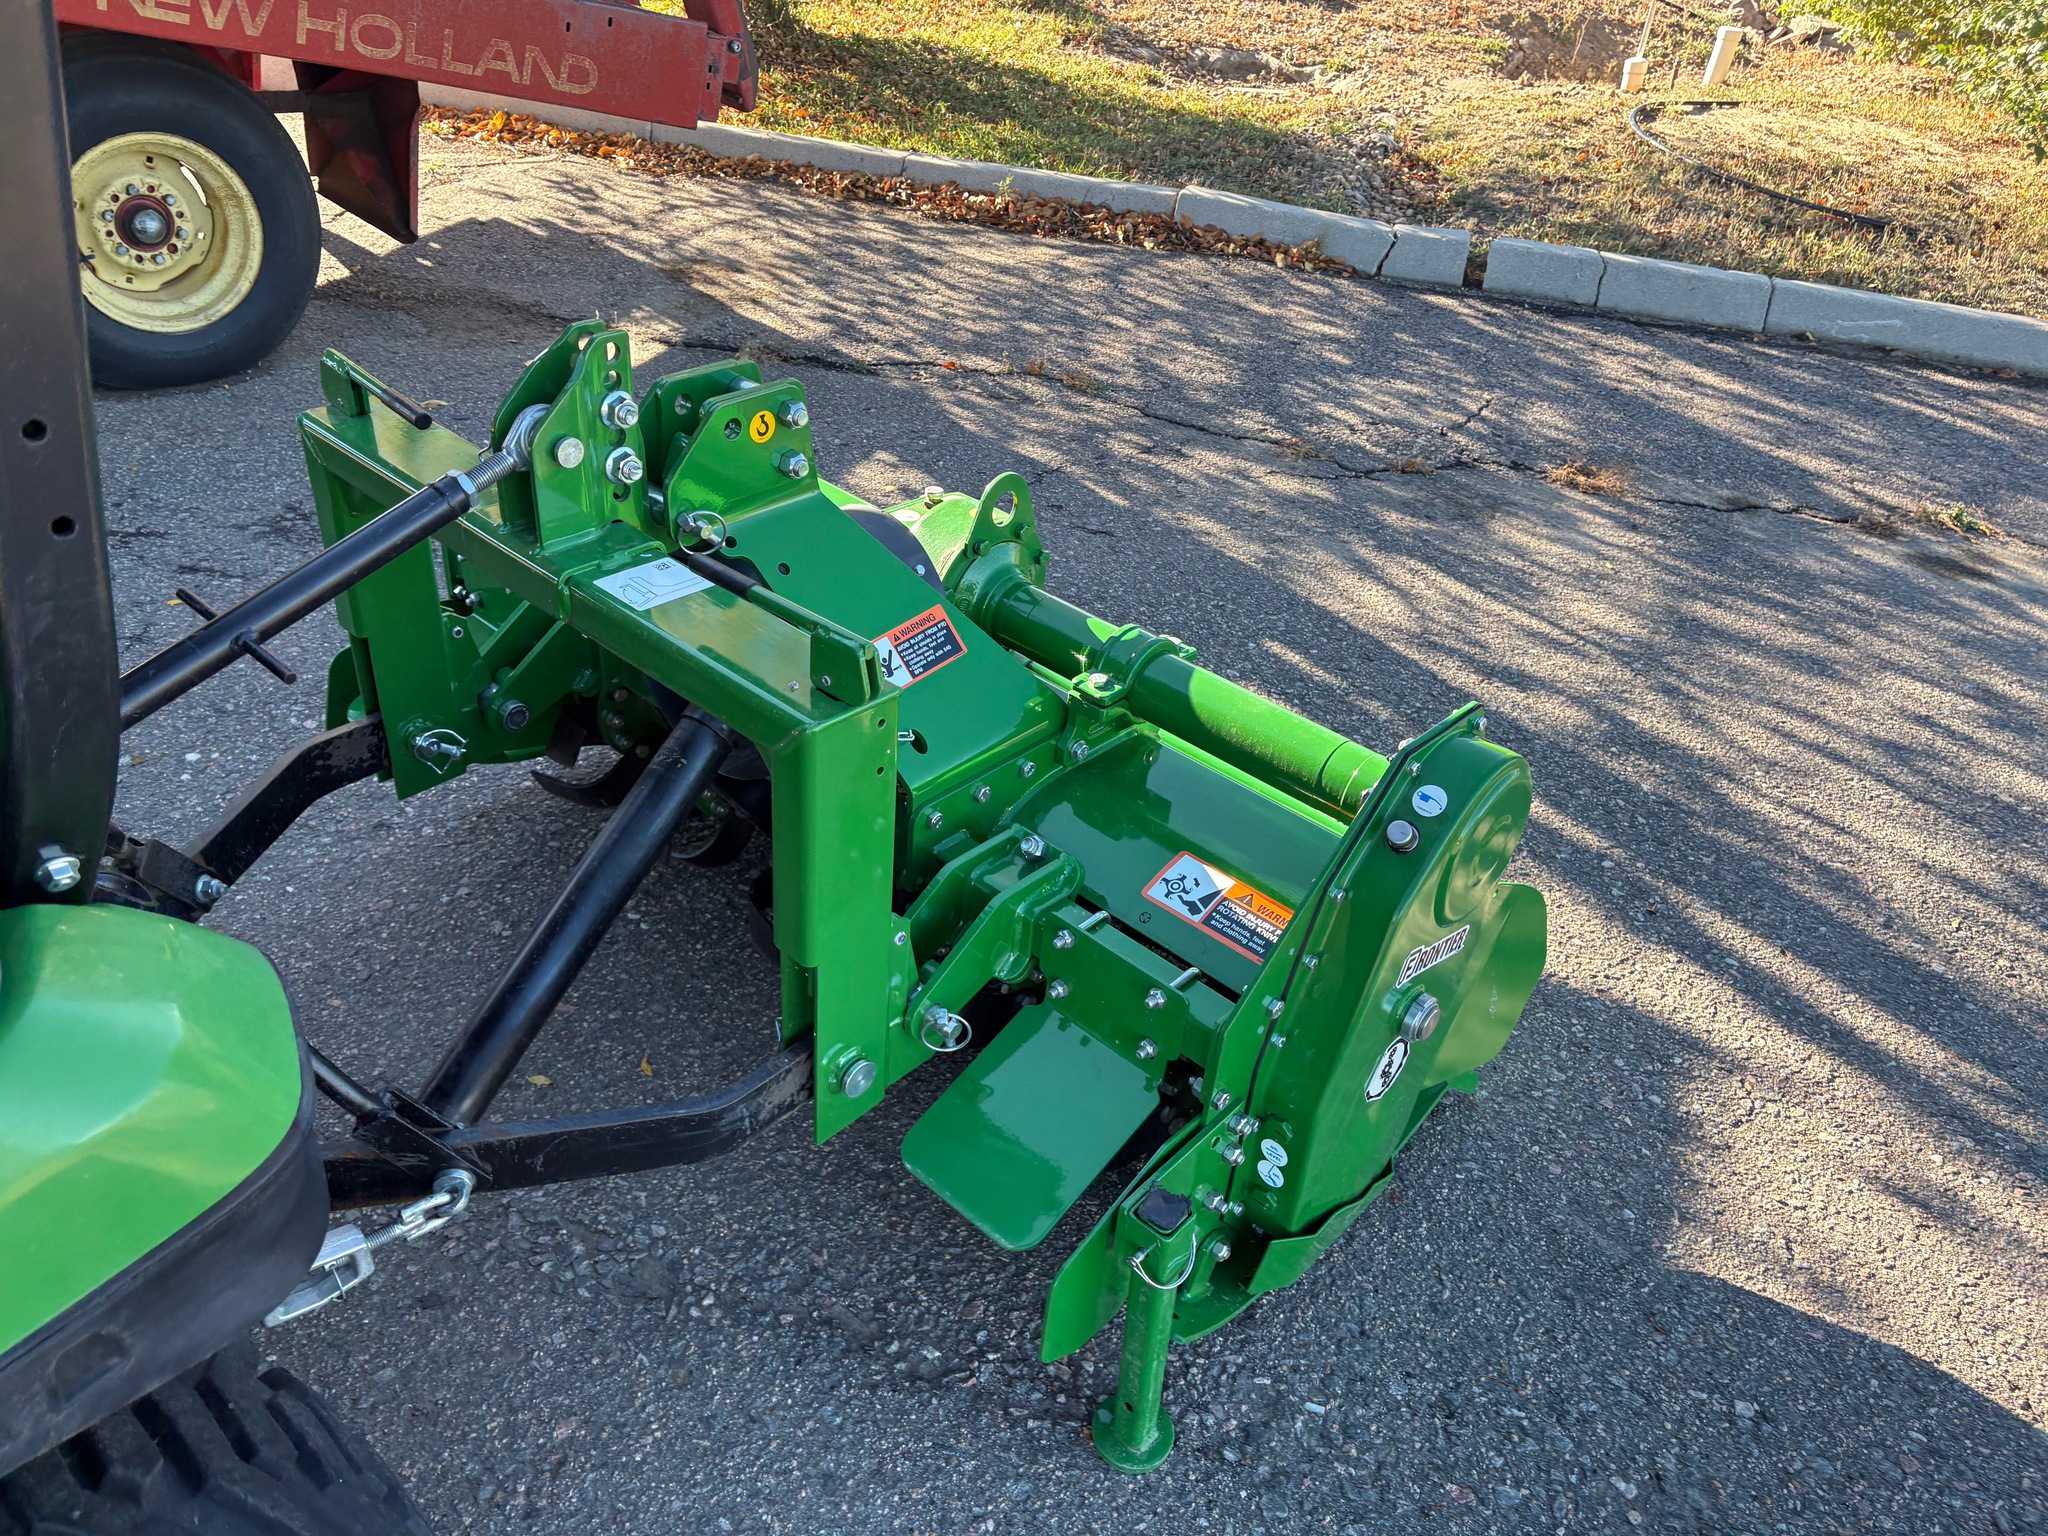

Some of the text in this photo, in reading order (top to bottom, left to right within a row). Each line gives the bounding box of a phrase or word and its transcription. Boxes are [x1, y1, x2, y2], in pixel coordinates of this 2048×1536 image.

[97, 0, 598, 95] EW HOLLAND
[897, 621, 947, 652] AVOID INJURY FROM PTO
[898, 613, 936, 638] WARNING
[936, 629, 947, 639] place
[1214, 914, 1266, 946] Keep hands, feet
[1216, 905, 1257, 930] ROTATING
[1222, 900, 1247, 917] AVOID
[1245, 912, 1277, 932] INJURY
[1210, 920, 1266, 954] and clothing away
[1397, 926, 1469, 987] FRONTIER
[1266, 1151, 1282, 1163] LEVEL
